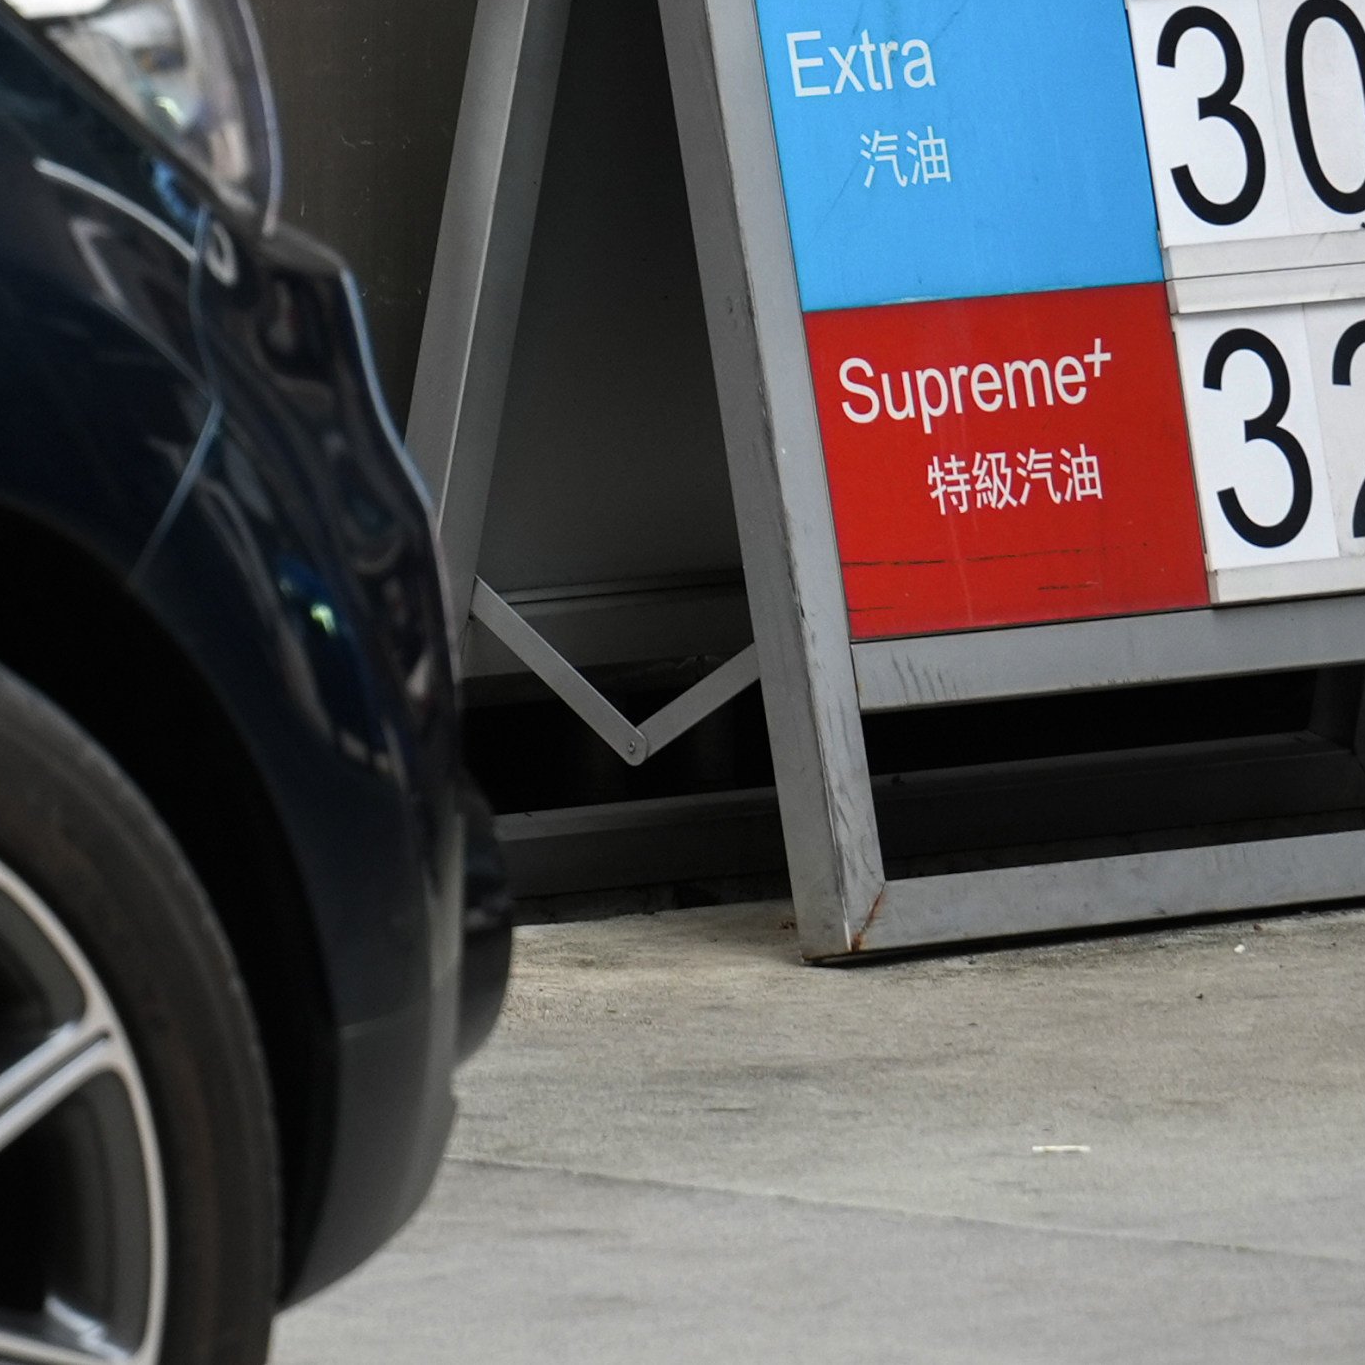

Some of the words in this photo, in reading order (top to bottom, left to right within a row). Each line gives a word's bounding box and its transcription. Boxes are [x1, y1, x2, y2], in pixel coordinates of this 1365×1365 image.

[785, 29, 936, 97] Extra
[860, 125, 952, 188] 汽油
[838, 338, 1112, 434] Supreme+
[927, 444, 1103, 515] 特級汽油
